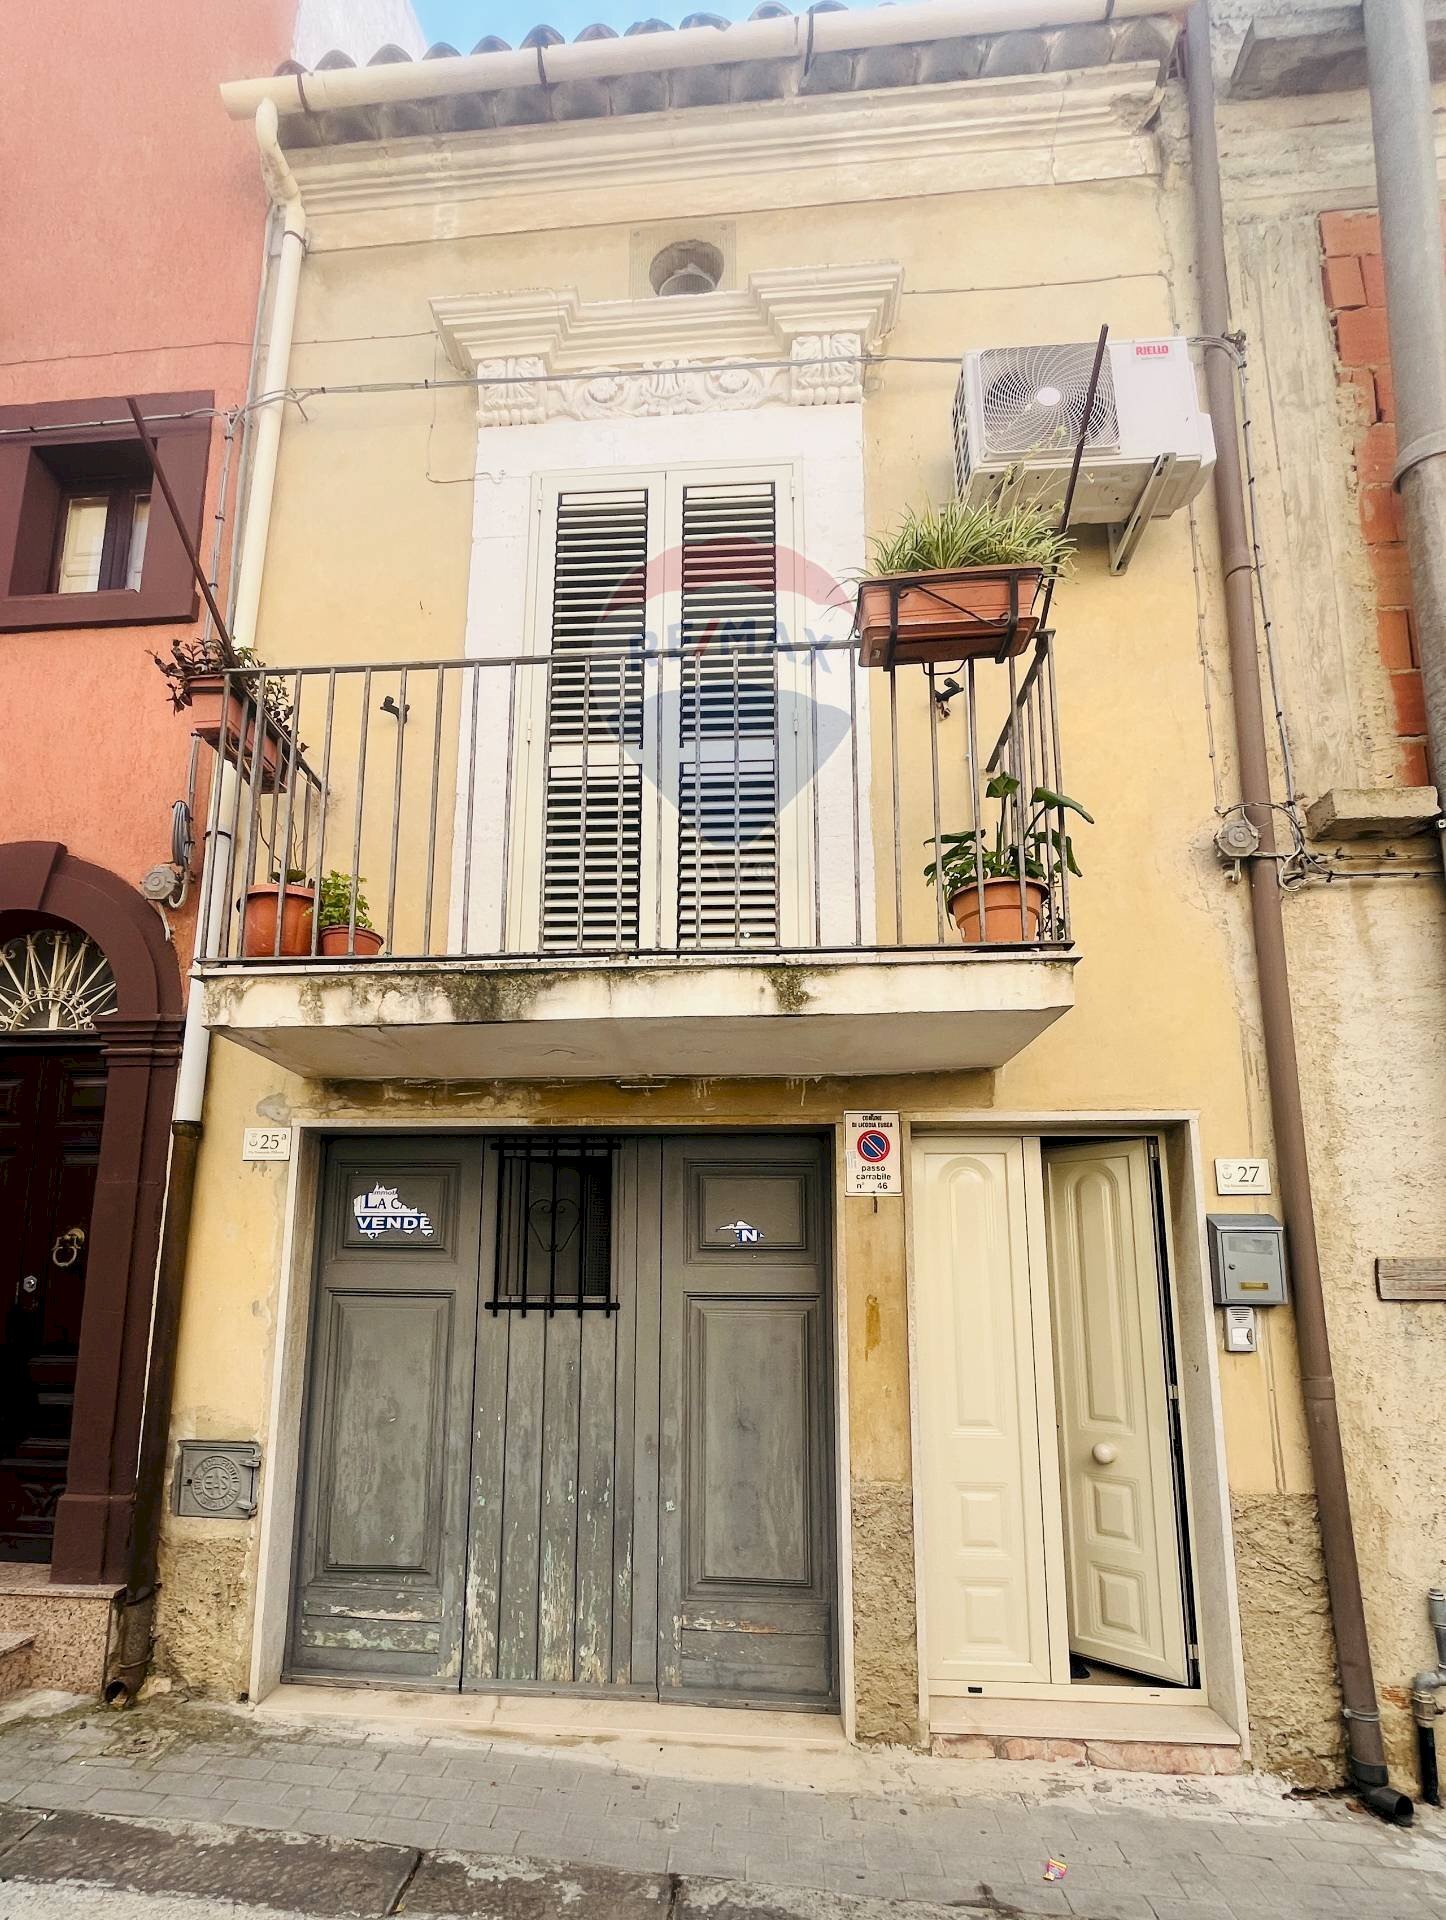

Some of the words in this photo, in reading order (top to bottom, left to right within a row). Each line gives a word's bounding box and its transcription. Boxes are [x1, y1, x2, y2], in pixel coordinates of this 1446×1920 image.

[1136, 345, 1168, 355] RIELLO
[1237, 1166, 1260, 1182] 27
[357, 1216, 433, 1229] VENDE
